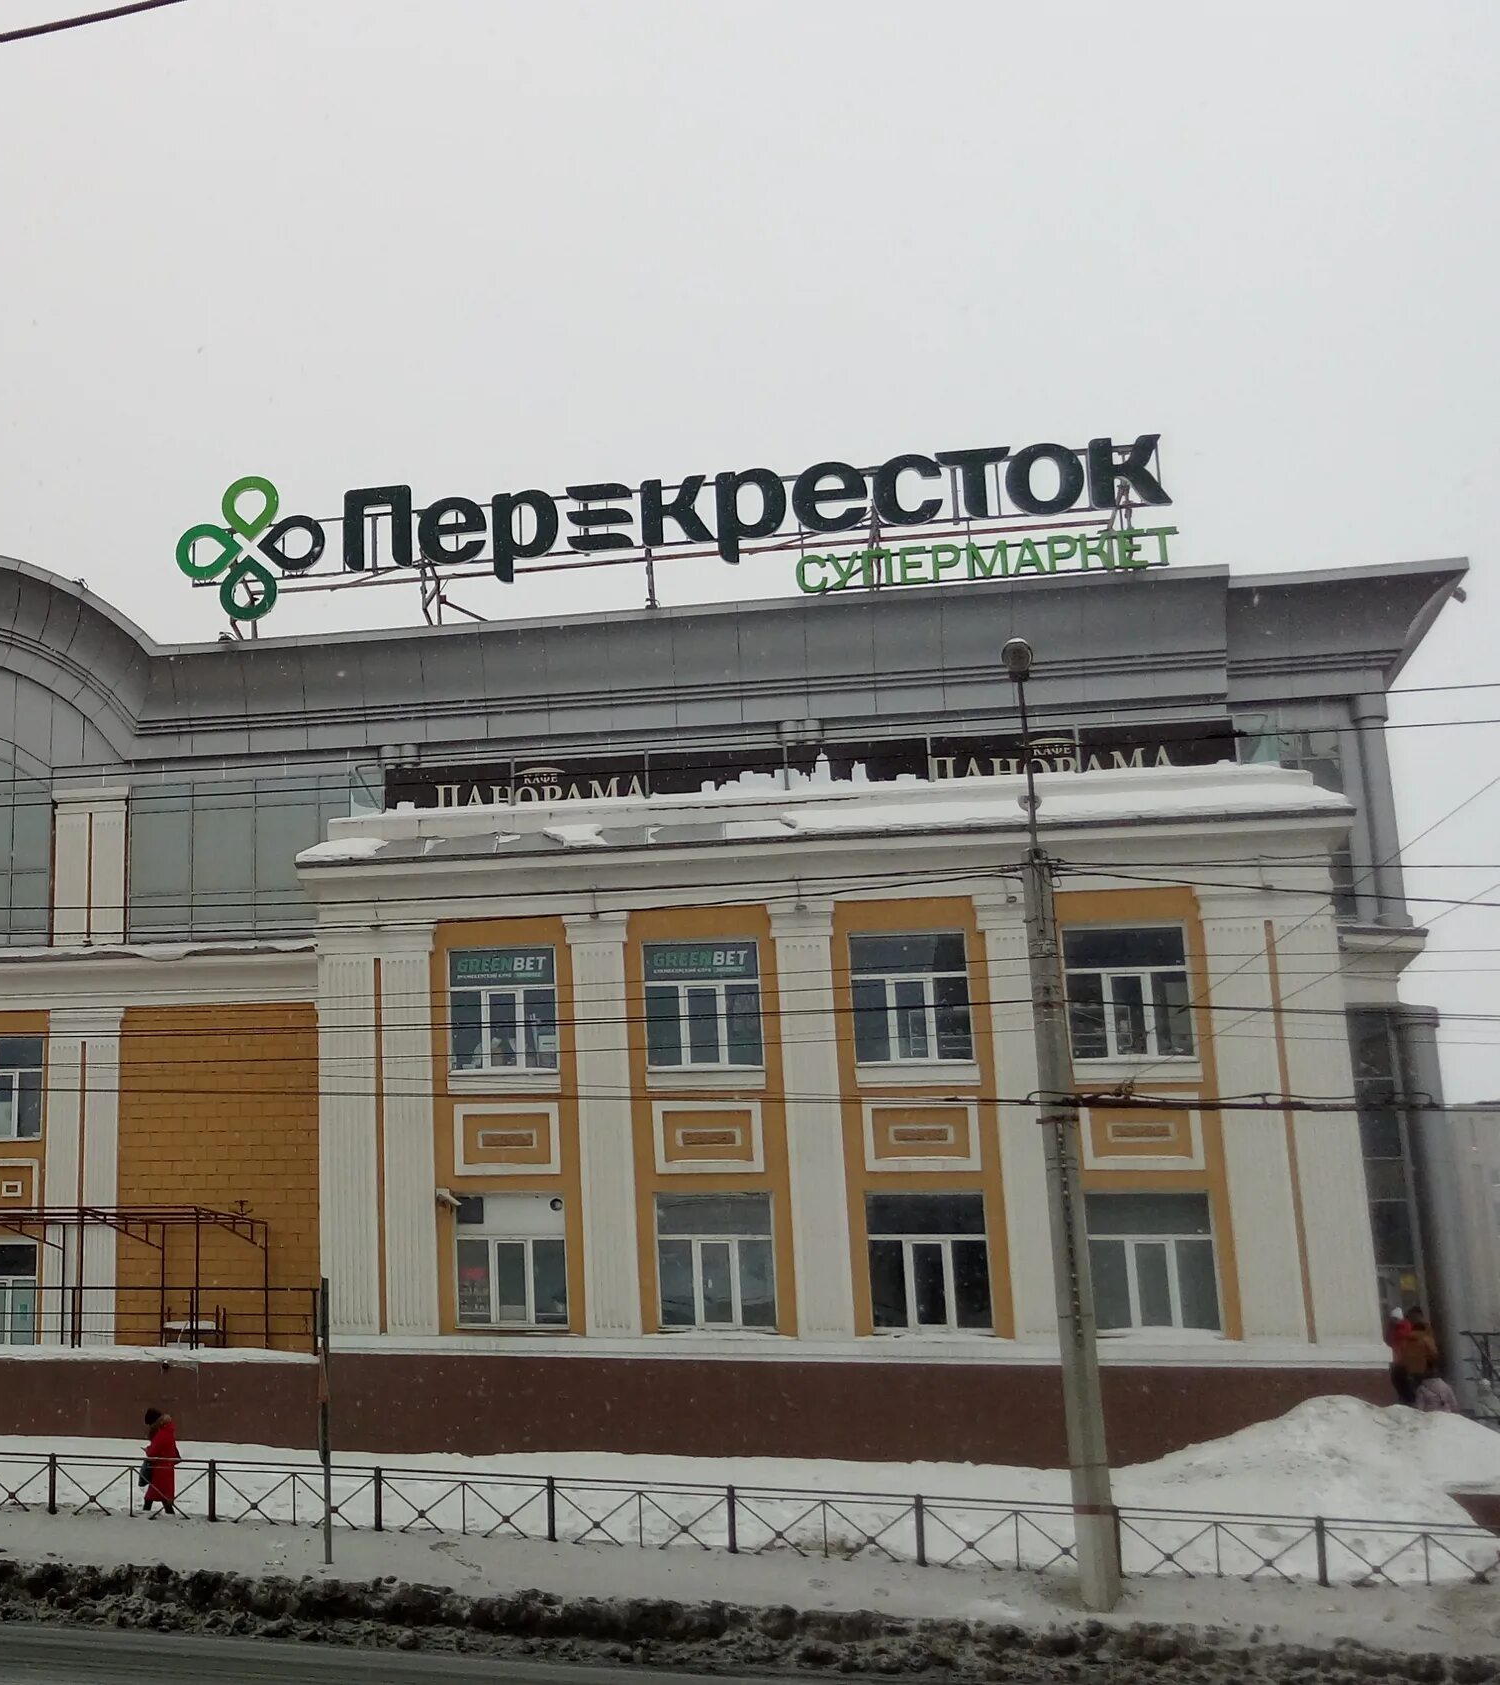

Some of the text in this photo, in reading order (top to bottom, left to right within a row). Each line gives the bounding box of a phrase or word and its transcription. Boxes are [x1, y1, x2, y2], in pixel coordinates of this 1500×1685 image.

[343, 434, 1173, 584] Перекресток
[795, 526, 1178, 593] СУПЕРМАРКЕТ
[1033, 745, 1073, 756] КАФЕ
[523, 773, 559, 785] КАФЕ
[457, 956, 547, 973] GREENBET
[653, 950, 748, 968] GREENBET
